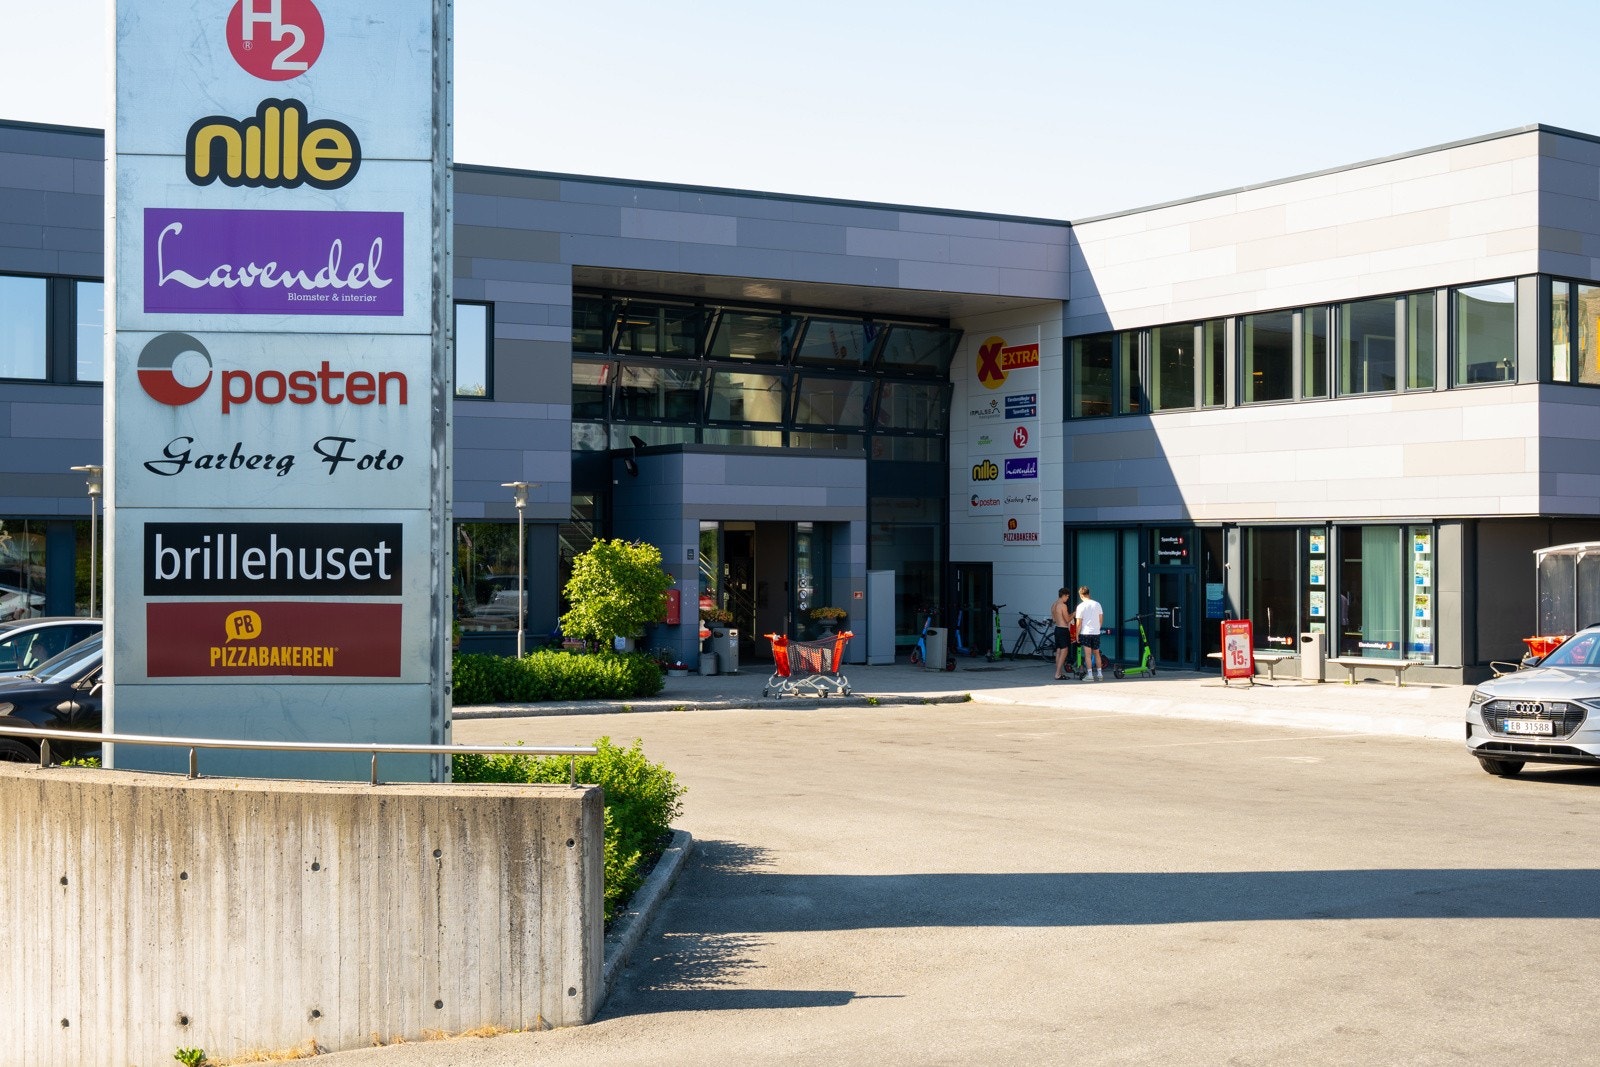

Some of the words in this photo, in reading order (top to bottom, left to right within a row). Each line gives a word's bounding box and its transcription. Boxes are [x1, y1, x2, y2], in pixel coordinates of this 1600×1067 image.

[190, 102, 357, 186] nille
[157, 222, 392, 290] Lavendel
[287, 292, 329, 301] Blomster
[331, 293, 339, 302] &
[341, 293, 378, 302] interiør
[1001, 350, 1039, 366] EXTRA
[221, 361, 408, 414] posten
[143, 436, 296, 477] Garberg
[312, 436, 405, 476] Foto
[973, 460, 998, 480] nille
[979, 498, 1001, 508] posten
[154, 533, 392, 581] brillehuset
[233, 614, 254, 635] PB
[210, 646, 334, 667] PIZZABAKEREN
[1524, 722, 1550, 732] 31588
